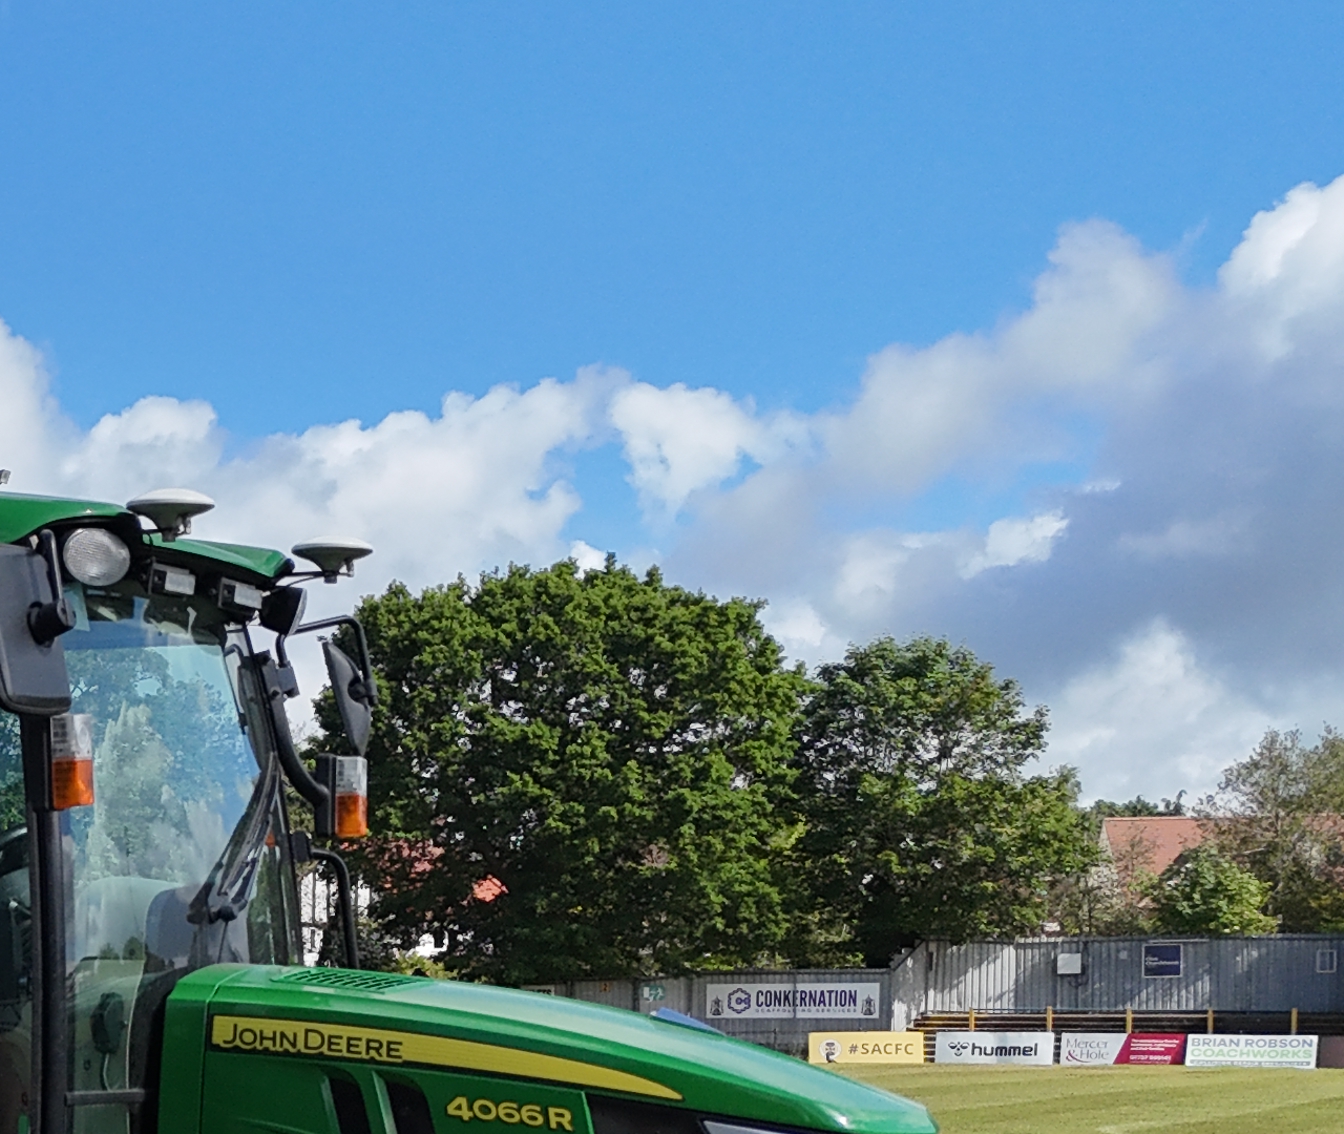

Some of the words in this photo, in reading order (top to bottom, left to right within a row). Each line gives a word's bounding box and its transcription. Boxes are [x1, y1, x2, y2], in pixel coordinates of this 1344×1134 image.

[756, 989, 858, 1008] CONKERNATION
[223, 1023, 297, 1050] JOHN
[303, 1028, 404, 1059] DEERE
[1066, 1038, 1108, 1049] Mercer
[1191, 1038, 1240, 1048] BRIAN
[1245, 1038, 1313, 1048] ROBSON
[848, 1042, 914, 1055] #SACFC
[971, 1042, 1038, 1057] hummel
[1190, 1048, 1313, 1059] COACHWORKS
[1080, 1050, 1109, 1060] Hole
